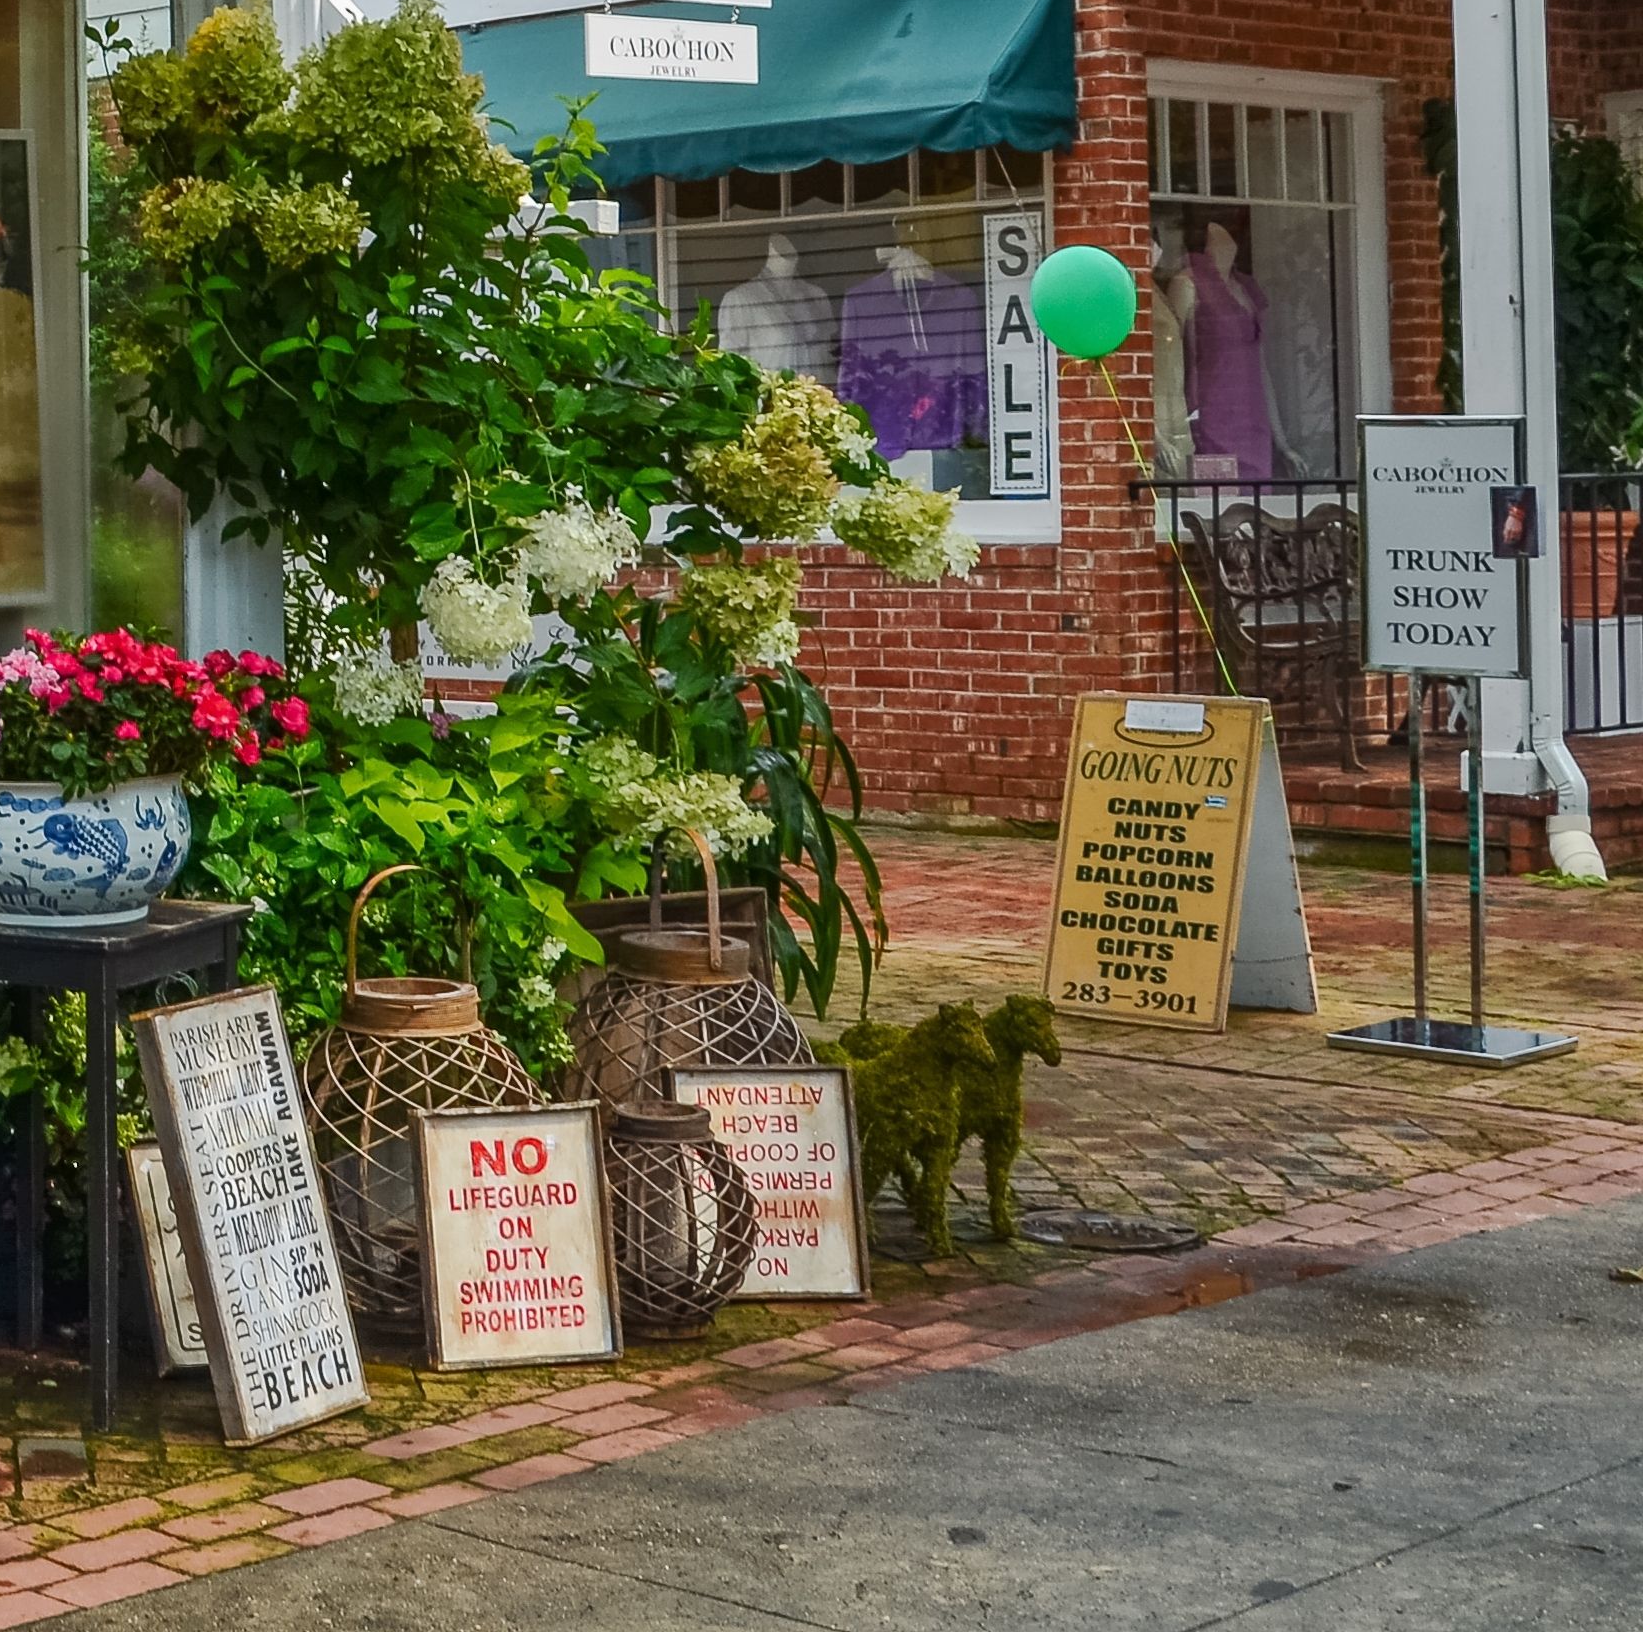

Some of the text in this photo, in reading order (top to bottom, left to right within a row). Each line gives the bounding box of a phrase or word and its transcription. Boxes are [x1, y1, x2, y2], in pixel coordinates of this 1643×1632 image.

[609, 35, 735, 62] CABOCHON
[650, 65, 698, 78] JEWELRY
[996, 225, 1035, 482] SALE
[1372, 466, 1508, 483] CABOCHON
[1415, 485, 1465, 494] JEWELRY
[1386, 549, 1495, 573] TRUNK
[1393, 585, 1489, 610] SHOW
[1386, 622, 1497, 647] TODAY
[1080, 750, 1238, 789] GOING NUTS
[1107, 797, 1201, 820] CANDY
[1114, 821, 1187, 843] NUTS
[1082, 842, 1214, 869] POPCORN
[1075, 865, 1214, 894] BALLOONS
[1104, 891, 1179, 914] SODA
[1060, 910, 1219, 943] CHOCOLATE
[1096, 937, 1174, 961] GIFTS
[1097, 960, 1168, 984] TOYS
[169, 1014, 252, 1049] PARISH ART
[175, 1034, 258, 1074] MUSEUM
[179, 1060, 268, 1112] WINDMILL LANE
[697, 1086, 824, 1105] ATTENDANT
[254, 1011, 309, 1191] LAKE AGAWAM
[204, 1099, 278, 1152] NATIONAL
[722, 1115, 799, 1134] BEACH
[216, 1142, 283, 1179] COOPERS
[470, 1136, 549, 1178] NO
[807, 1143, 836, 1161] OF
[221, 1166, 290, 1211] BEACH
[449, 1182, 578, 1212] LIFEGUARD
[231, 1204, 285, 1256] MEADOW
[498, 1216, 532, 1240] ON
[756, 1227, 820, 1248] PARK
[187, 1118, 266, 1419] THE DRIVERS SEAT
[289, 1245, 307, 1266] SIP
[486, 1246, 550, 1273] DUTY
[757, 1256, 789, 1277] NO
[240, 1251, 289, 1292] GIN
[294, 1260, 332, 1300] SODA
[459, 1275, 584, 1305] SWIMMING
[252, 1297, 339, 1346] SHINNECOCK
[461, 1304, 586, 1335] PROHIBITED
[258, 1325, 344, 1371] LITTLE PLAINS
[264, 1347, 353, 1411] BEACH
